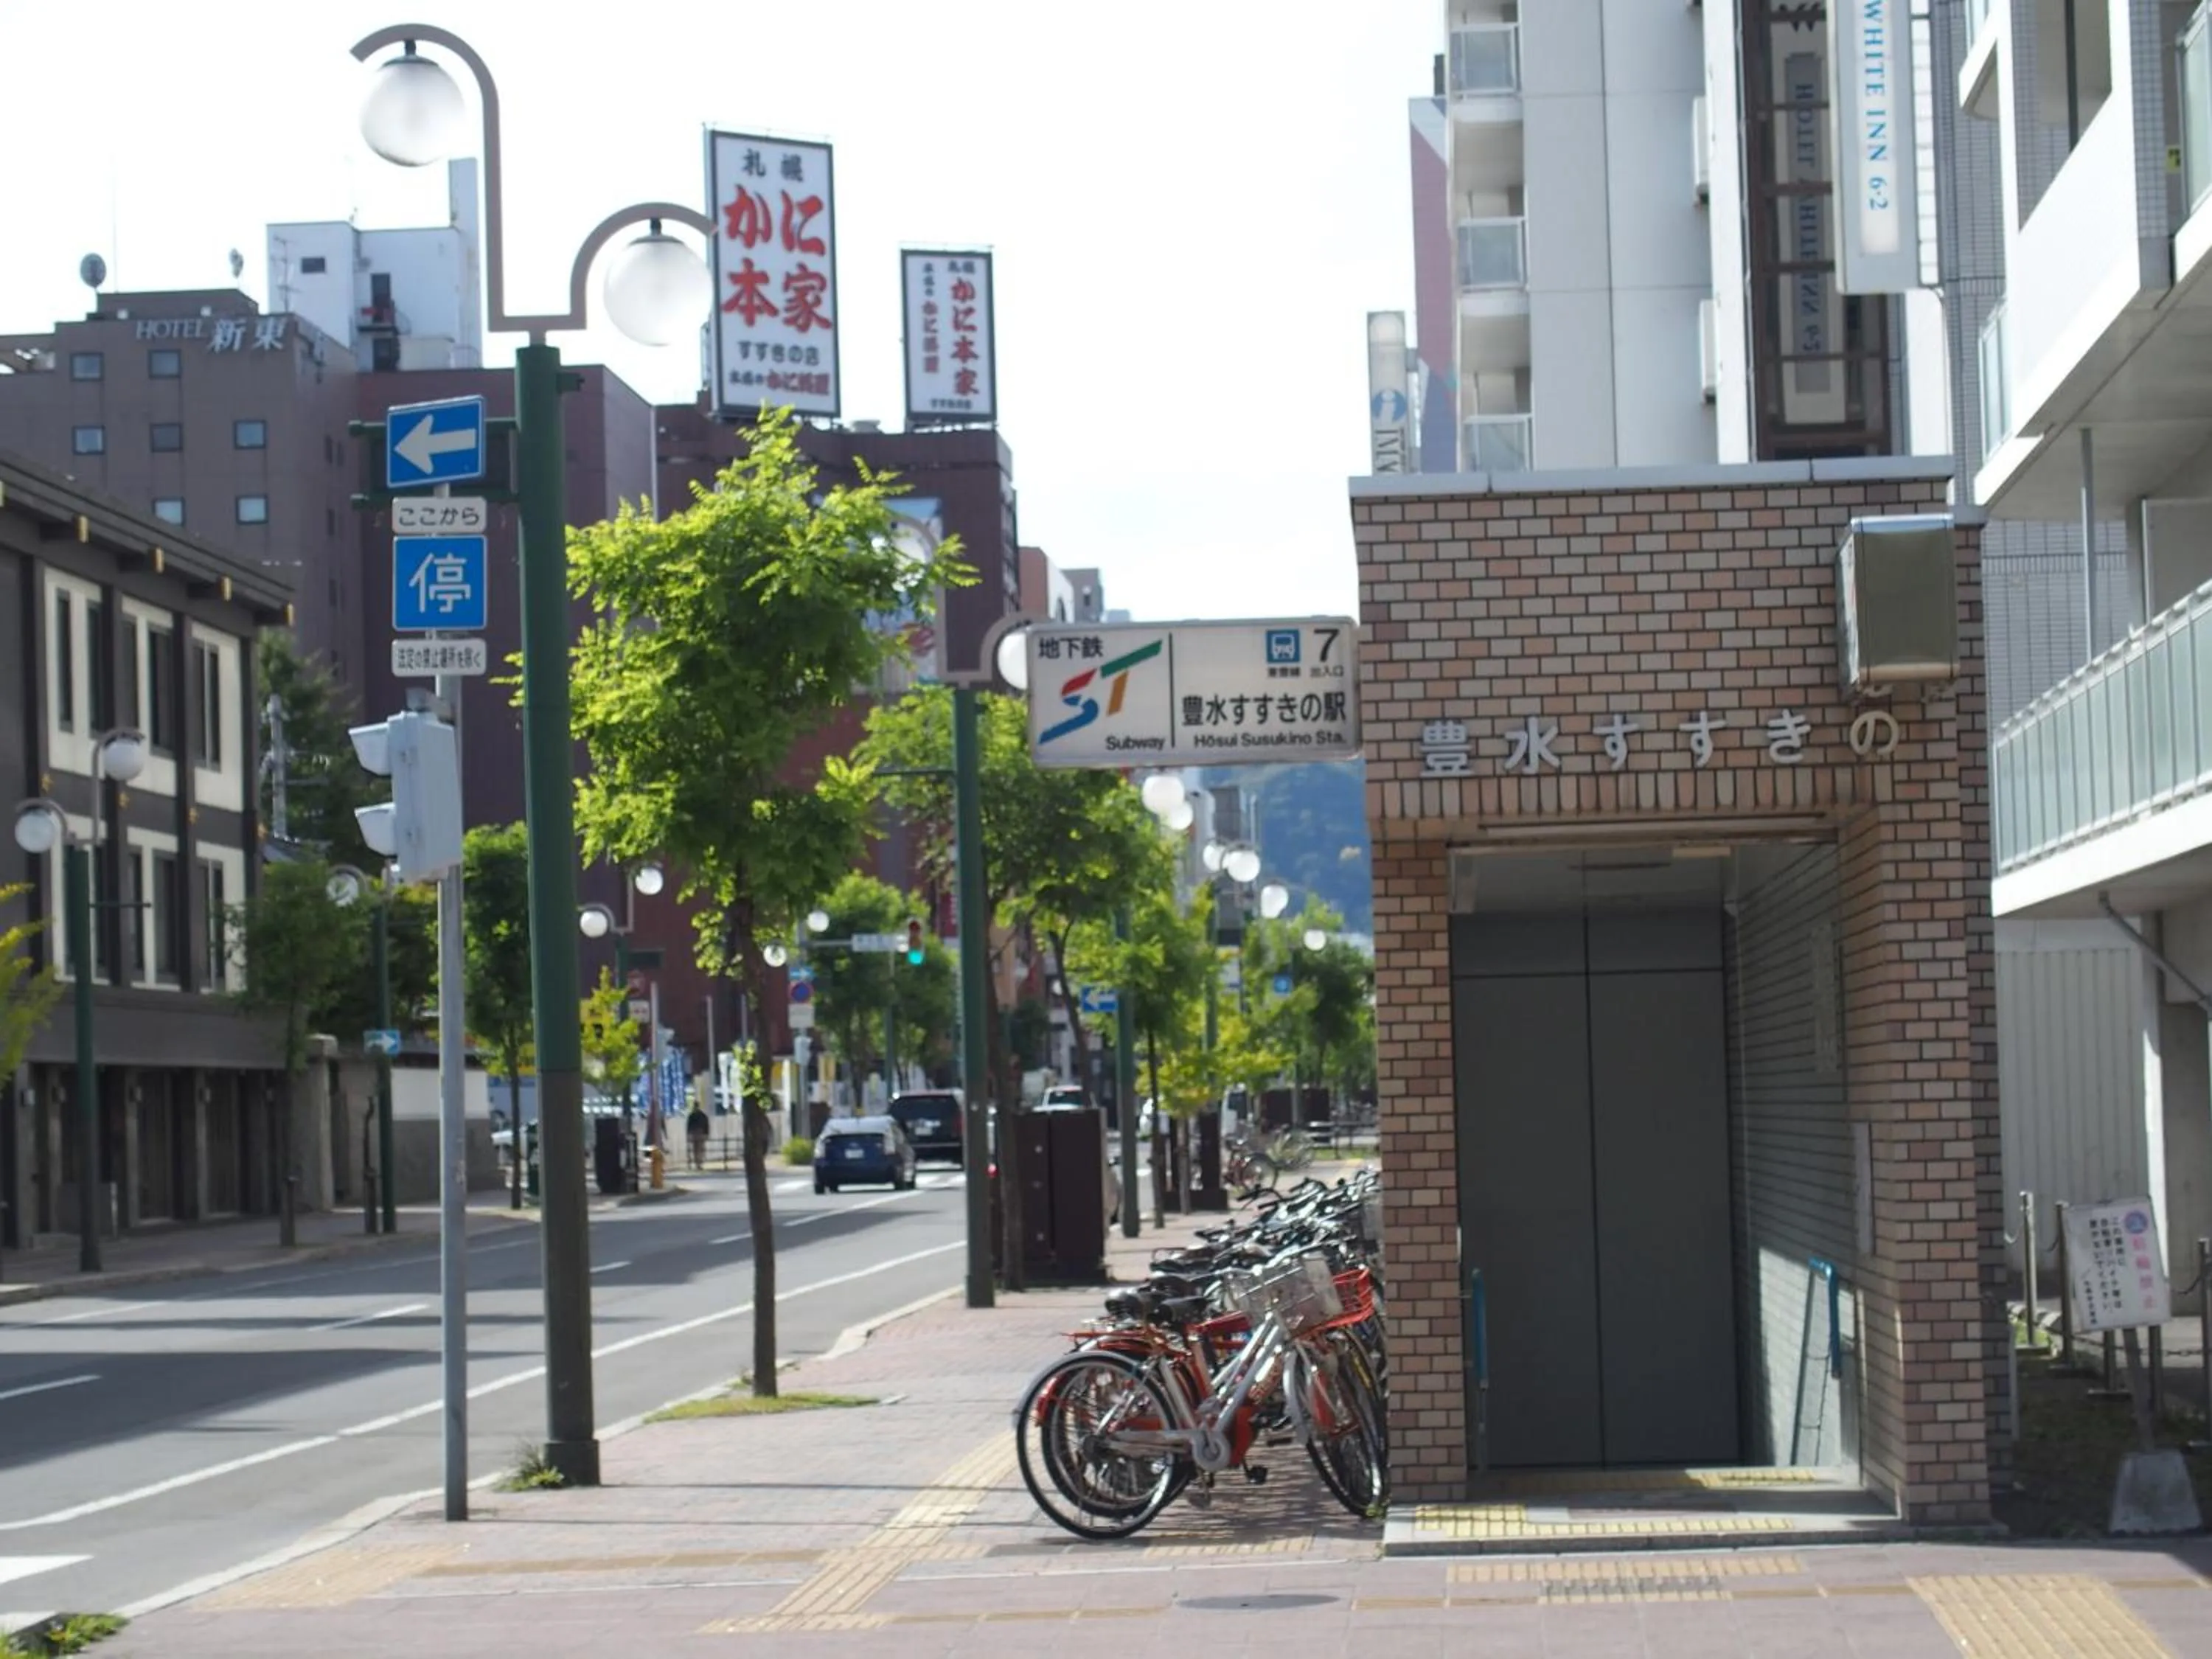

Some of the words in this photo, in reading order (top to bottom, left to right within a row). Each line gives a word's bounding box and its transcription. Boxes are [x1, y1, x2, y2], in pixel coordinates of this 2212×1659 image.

[1863, 0, 1885, 97] WHITE
[1866, 110, 1888, 161] INN
[741, 148, 804, 182] 札幌
[722, 184, 826, 257] かに
[720, 257, 833, 333] 本家
[136, 319, 208, 339] HOTEL
[207, 317, 288, 353] 新東
[950, 276, 980, 397] かに本家
[398, 506, 480, 526] ここから
[408, 552, 471, 613] 停
[1039, 636, 1105, 660] 地下鉄
[1313, 628, 1340, 663] 7
[1182, 692, 1346, 726] 豊水すすきの駅
[1105, 736, 1166, 751] Subway
[1240, 730, 1312, 747] Susukino
[1315, 729, 1347, 745] Sta.
[1419, 708, 1901, 778] 豊水すすきの
